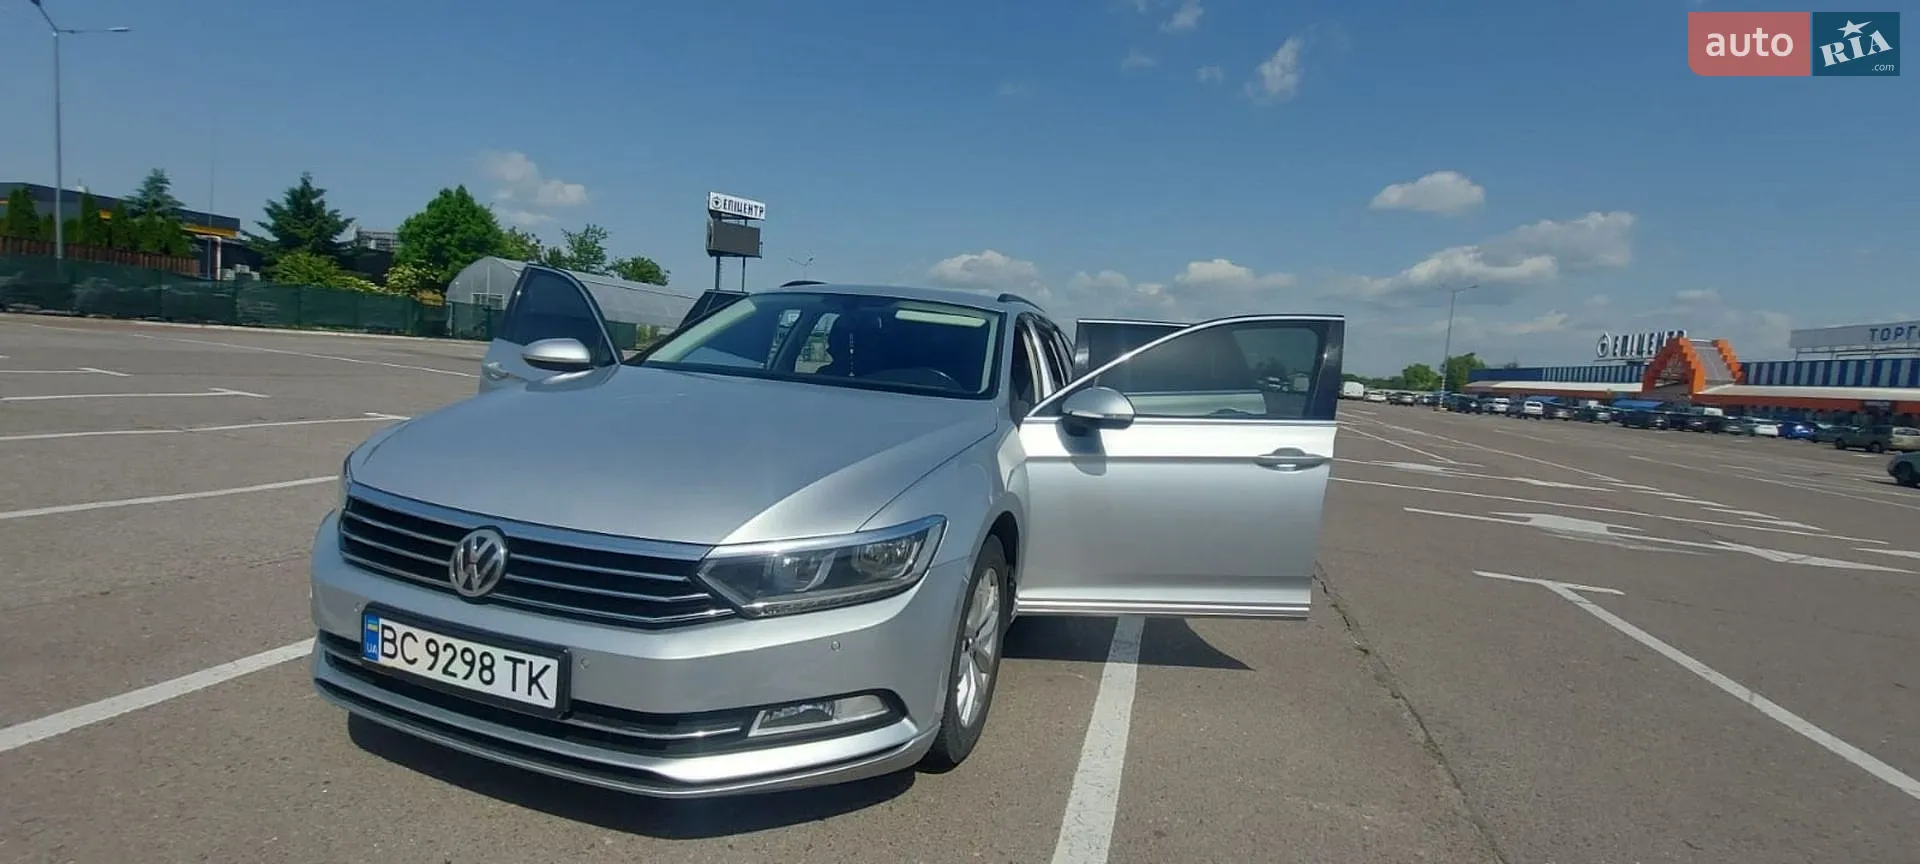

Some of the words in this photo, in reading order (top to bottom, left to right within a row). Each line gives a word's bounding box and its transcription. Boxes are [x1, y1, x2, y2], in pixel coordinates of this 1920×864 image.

[723, 198, 764, 217] ЕПІЦЕНТР
[1869, 324, 1920, 342] ТОРГ
[380, 623, 418, 666] BC
[425, 637, 496, 686] 9298
[504, 655, 551, 700] TK
